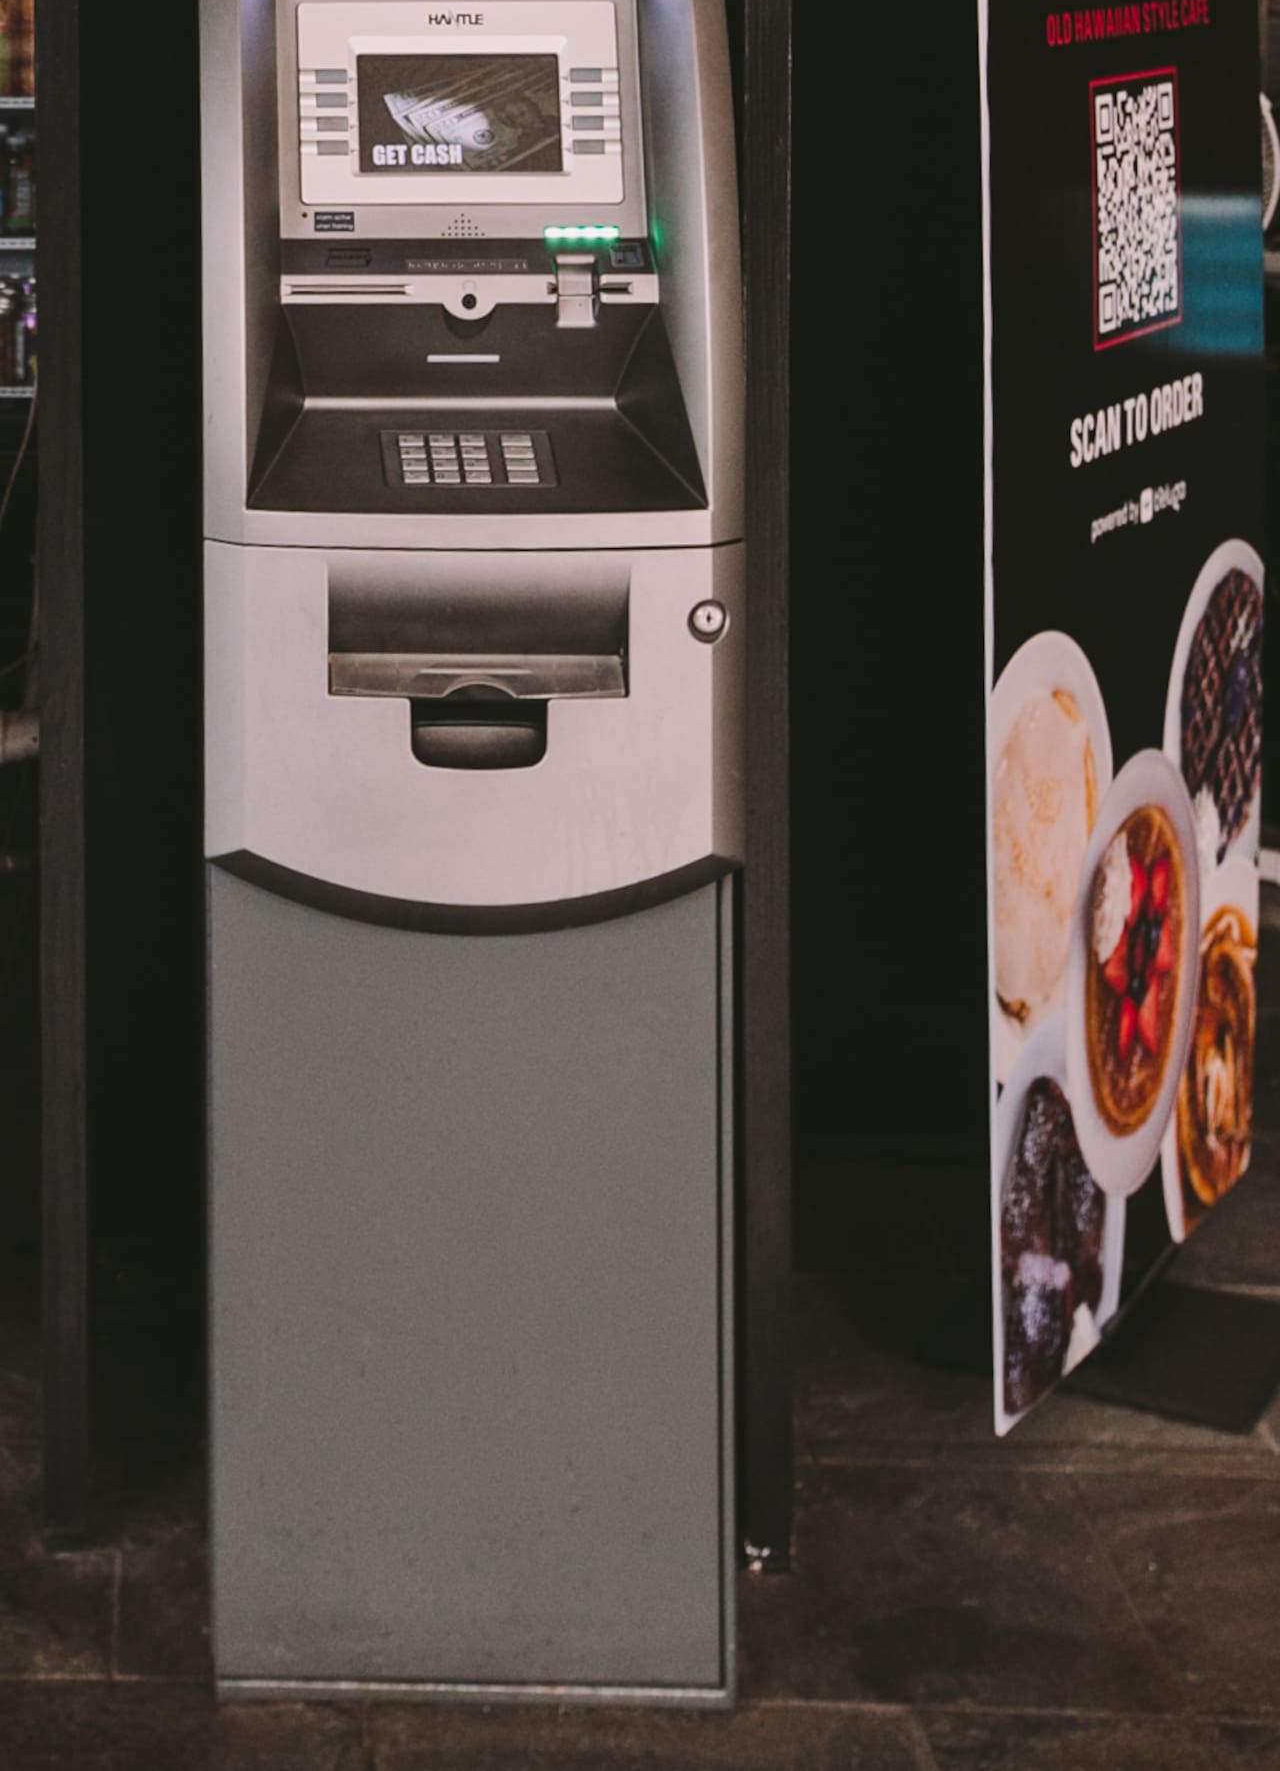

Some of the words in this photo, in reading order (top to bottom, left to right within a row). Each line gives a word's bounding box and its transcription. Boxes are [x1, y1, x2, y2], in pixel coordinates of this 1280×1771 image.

[1047, 12, 1071, 47] OLD
[1074, 5, 1141, 42] HAWAIIAN
[372, 144, 408, 166] GET
[411, 144, 463, 165] CASH
[1070, 402, 1120, 468] SCAN
[1124, 394, 1148, 446] TO
[1150, 372, 1203, 436] ORDER
